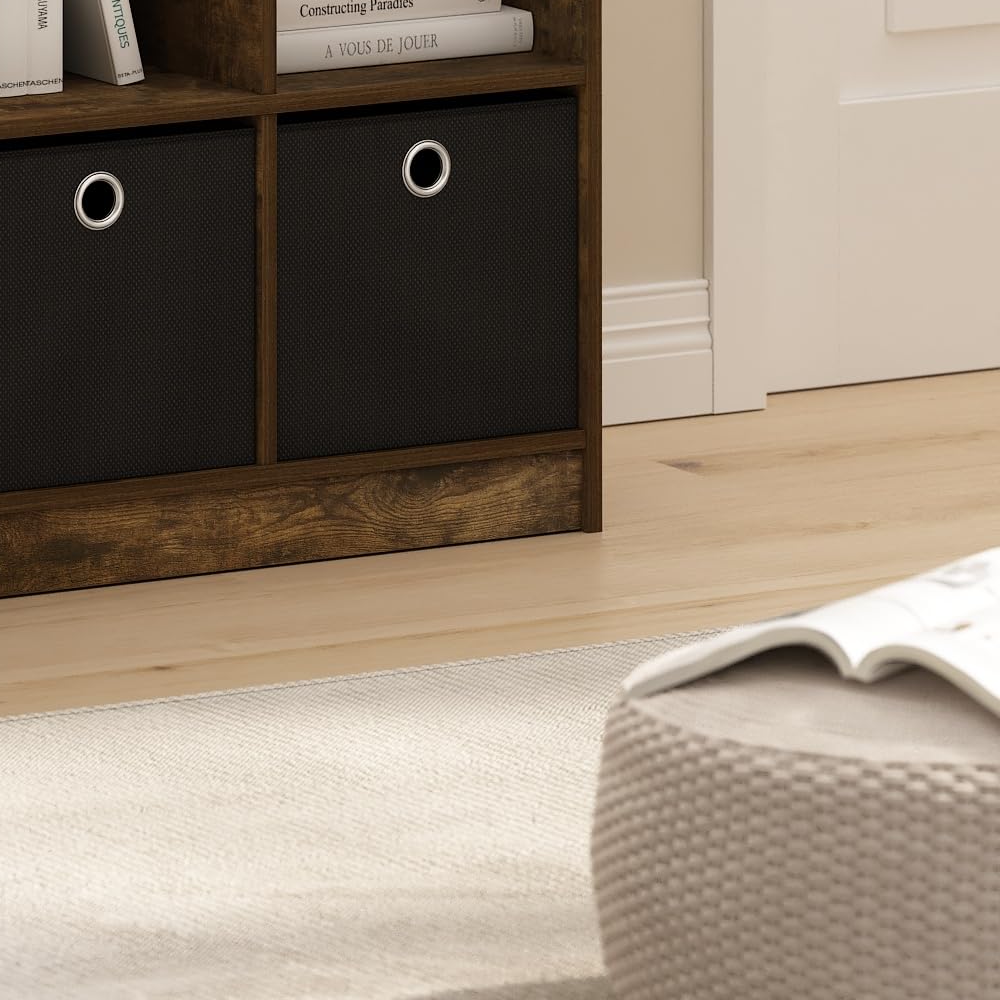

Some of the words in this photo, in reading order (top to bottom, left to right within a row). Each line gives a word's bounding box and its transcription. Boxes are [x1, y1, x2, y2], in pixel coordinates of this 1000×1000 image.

[300, 0, 367, 18] Constructing
[324, 45, 334, 59] A
[339, 40, 372, 56] VOUS
[377, 38, 394, 53] DE
[397, 33, 439, 55] JOUER
[26, 78, 63, 86] TASCHEN
